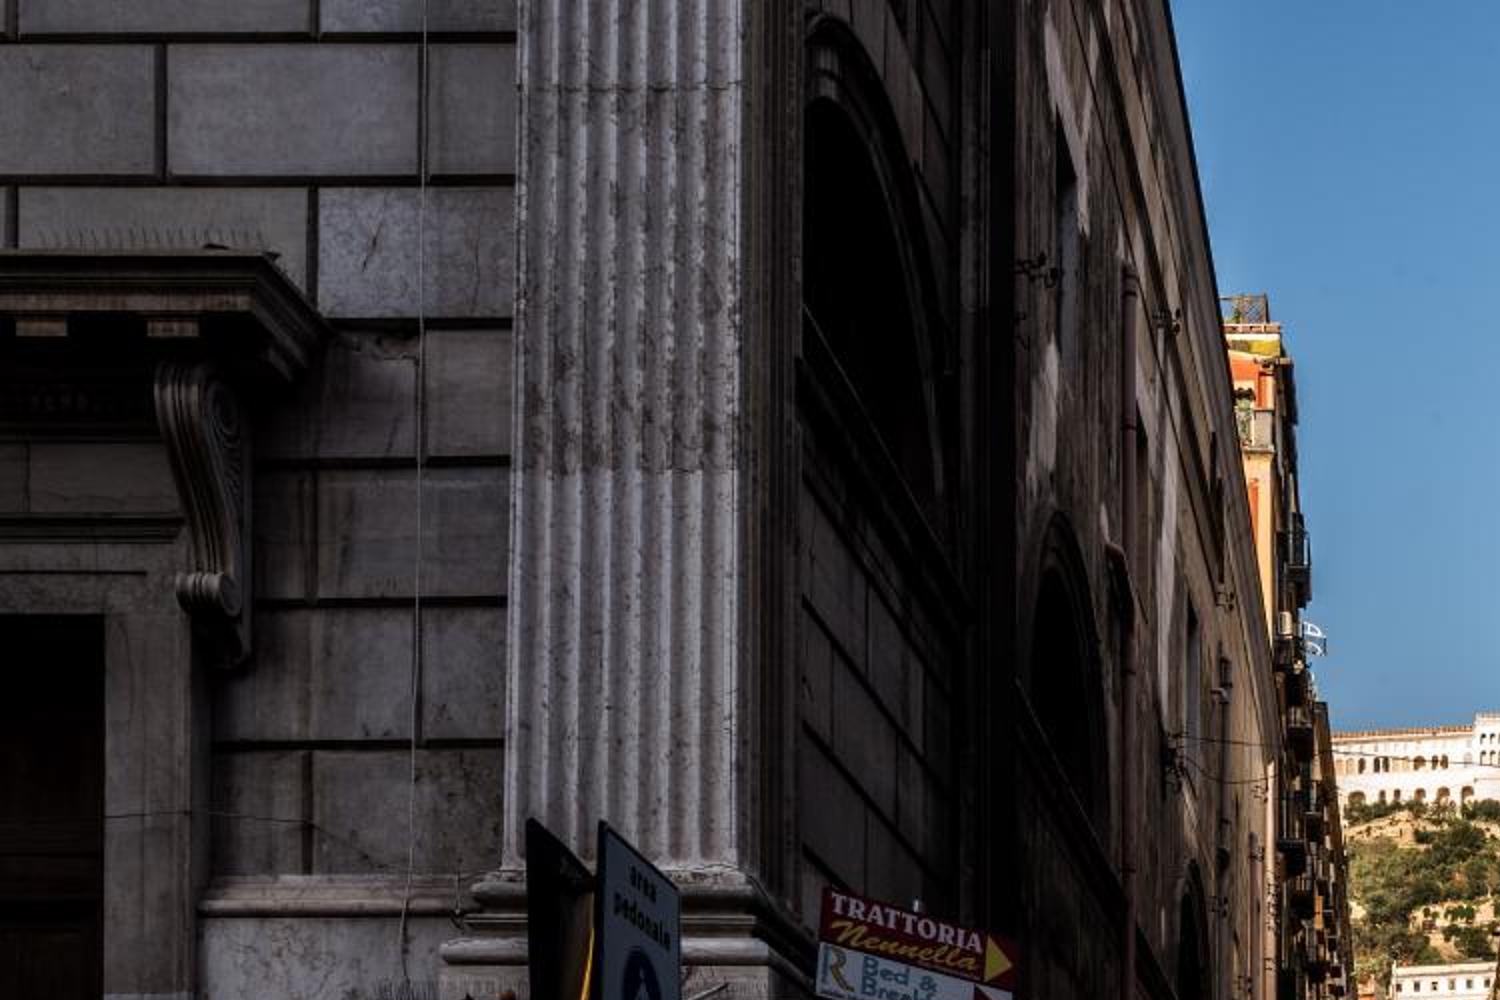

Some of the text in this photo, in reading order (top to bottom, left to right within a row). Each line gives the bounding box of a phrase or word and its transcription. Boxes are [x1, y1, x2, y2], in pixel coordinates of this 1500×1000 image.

[831, 891, 984, 955] TRATTORIA
[831, 918, 978, 972] Nennella
[863, 956, 938, 994] Bed &
